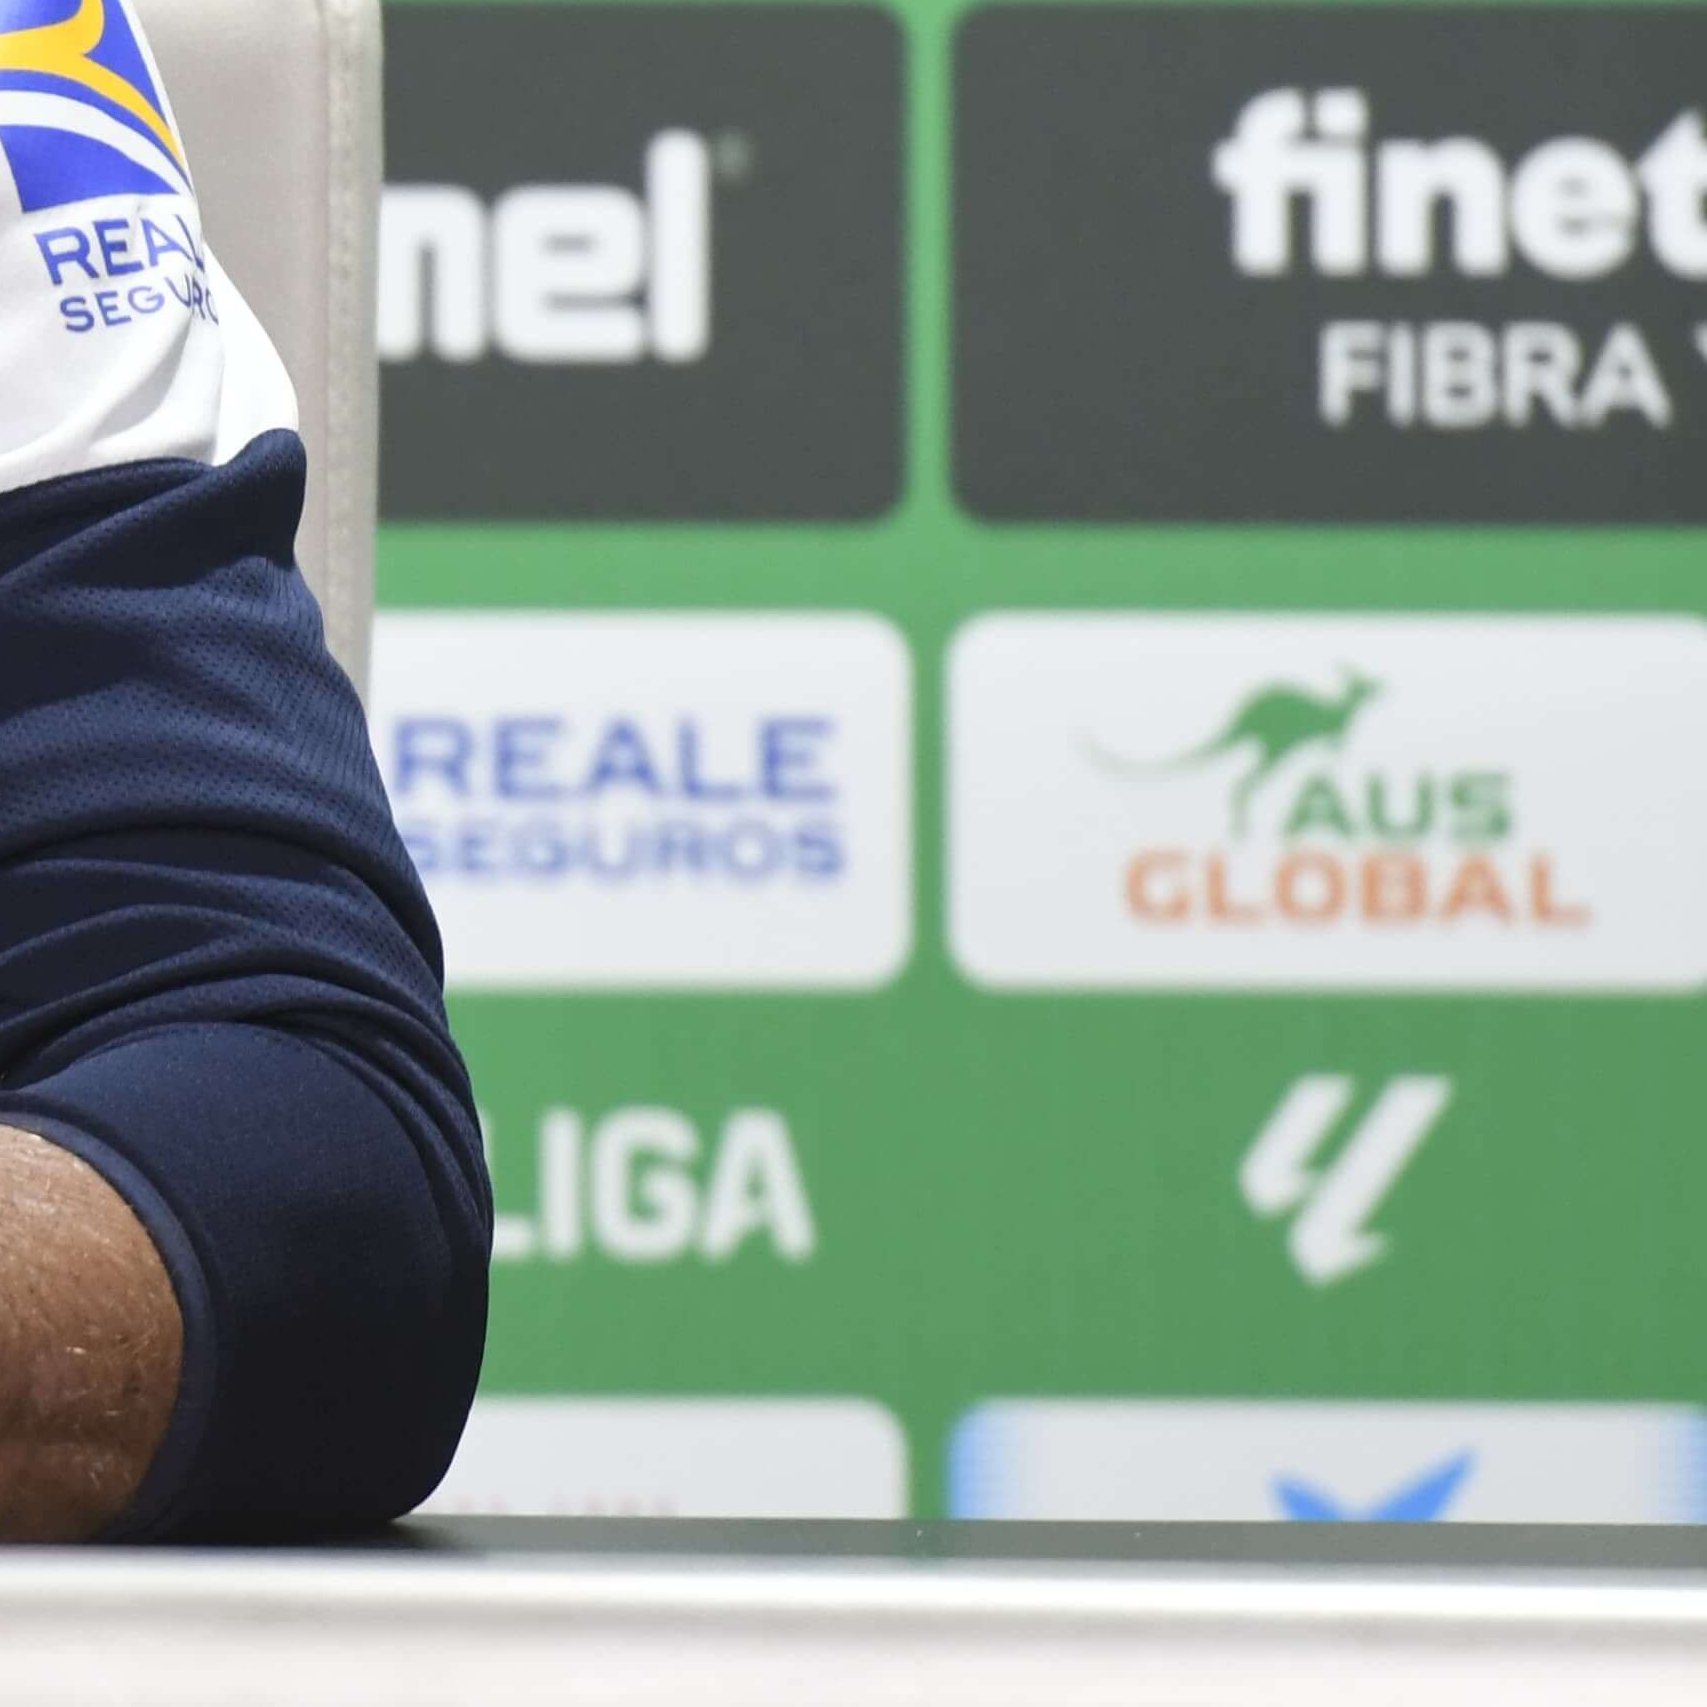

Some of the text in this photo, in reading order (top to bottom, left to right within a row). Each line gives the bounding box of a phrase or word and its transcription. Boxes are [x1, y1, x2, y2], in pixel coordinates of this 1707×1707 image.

[1319, 319, 1671, 429] FIBRA
[393, 714, 838, 804] REALE
[1282, 769, 1516, 846] AUS
[403, 816, 848, 884] SEGUROS
[1124, 848, 1591, 929] GLOBAL
